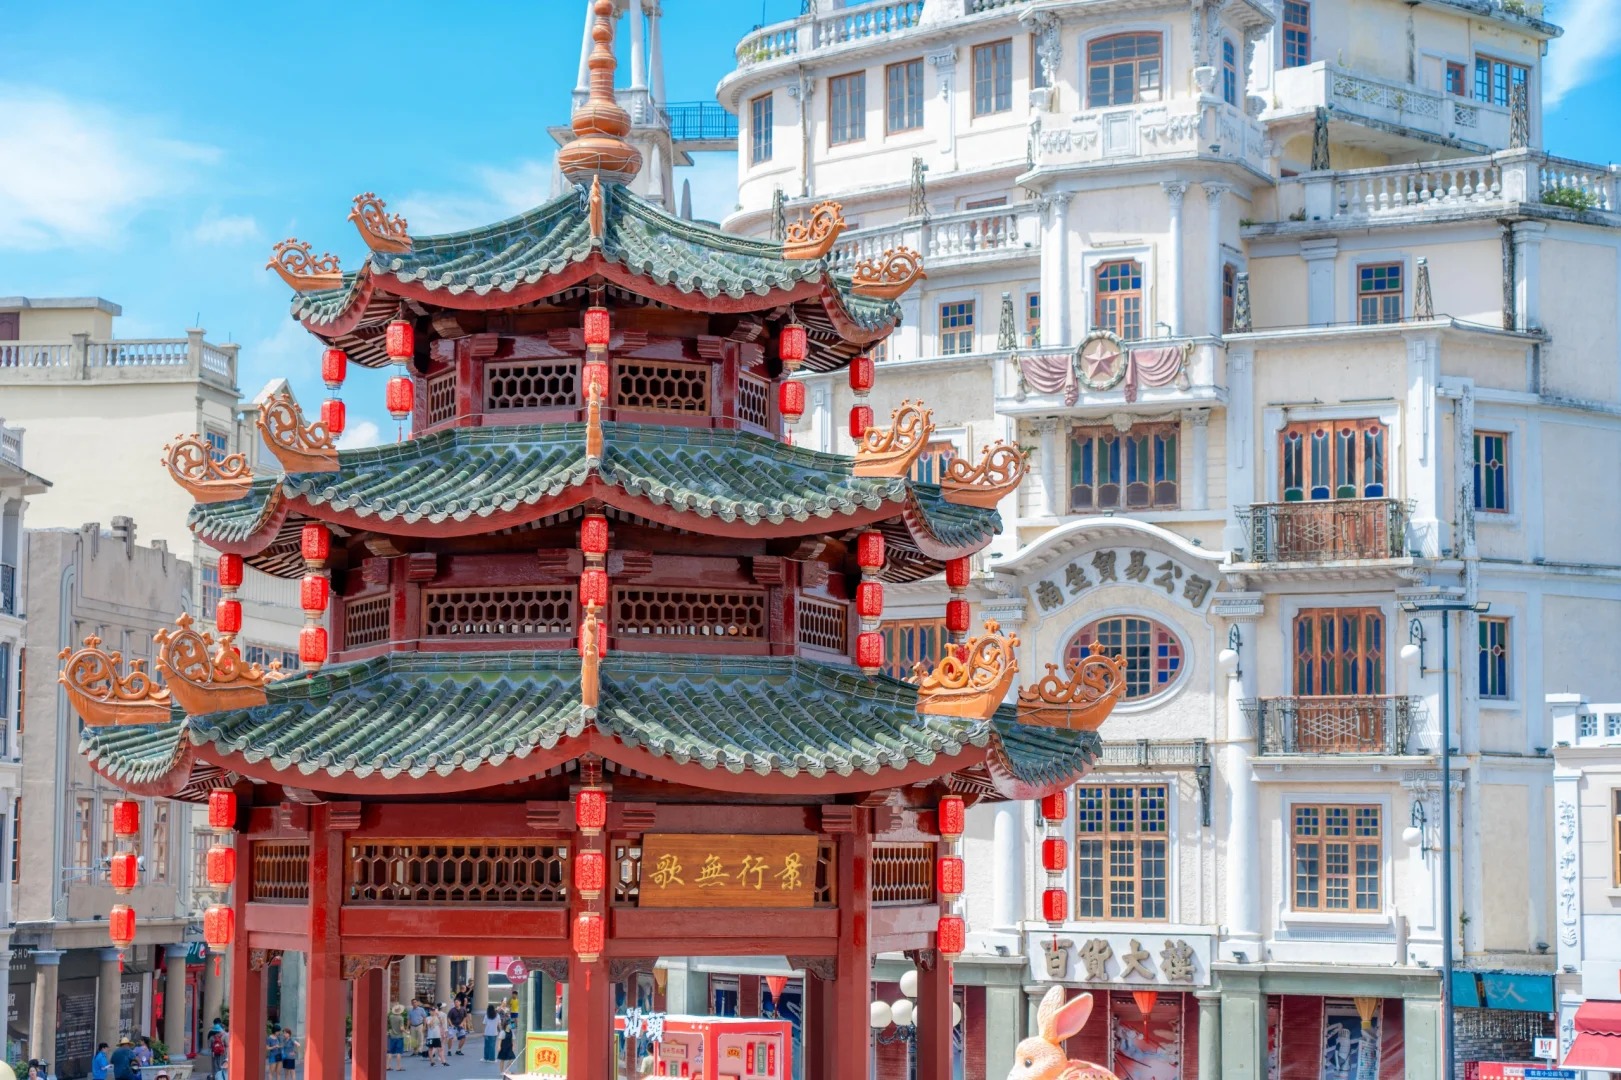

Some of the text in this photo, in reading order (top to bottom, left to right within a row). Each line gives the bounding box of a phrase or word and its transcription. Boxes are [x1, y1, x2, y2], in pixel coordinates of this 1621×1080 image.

[1035, 549, 1212, 611] 南生貿易公司
[1040, 937, 1197, 982] 百貨大樓
